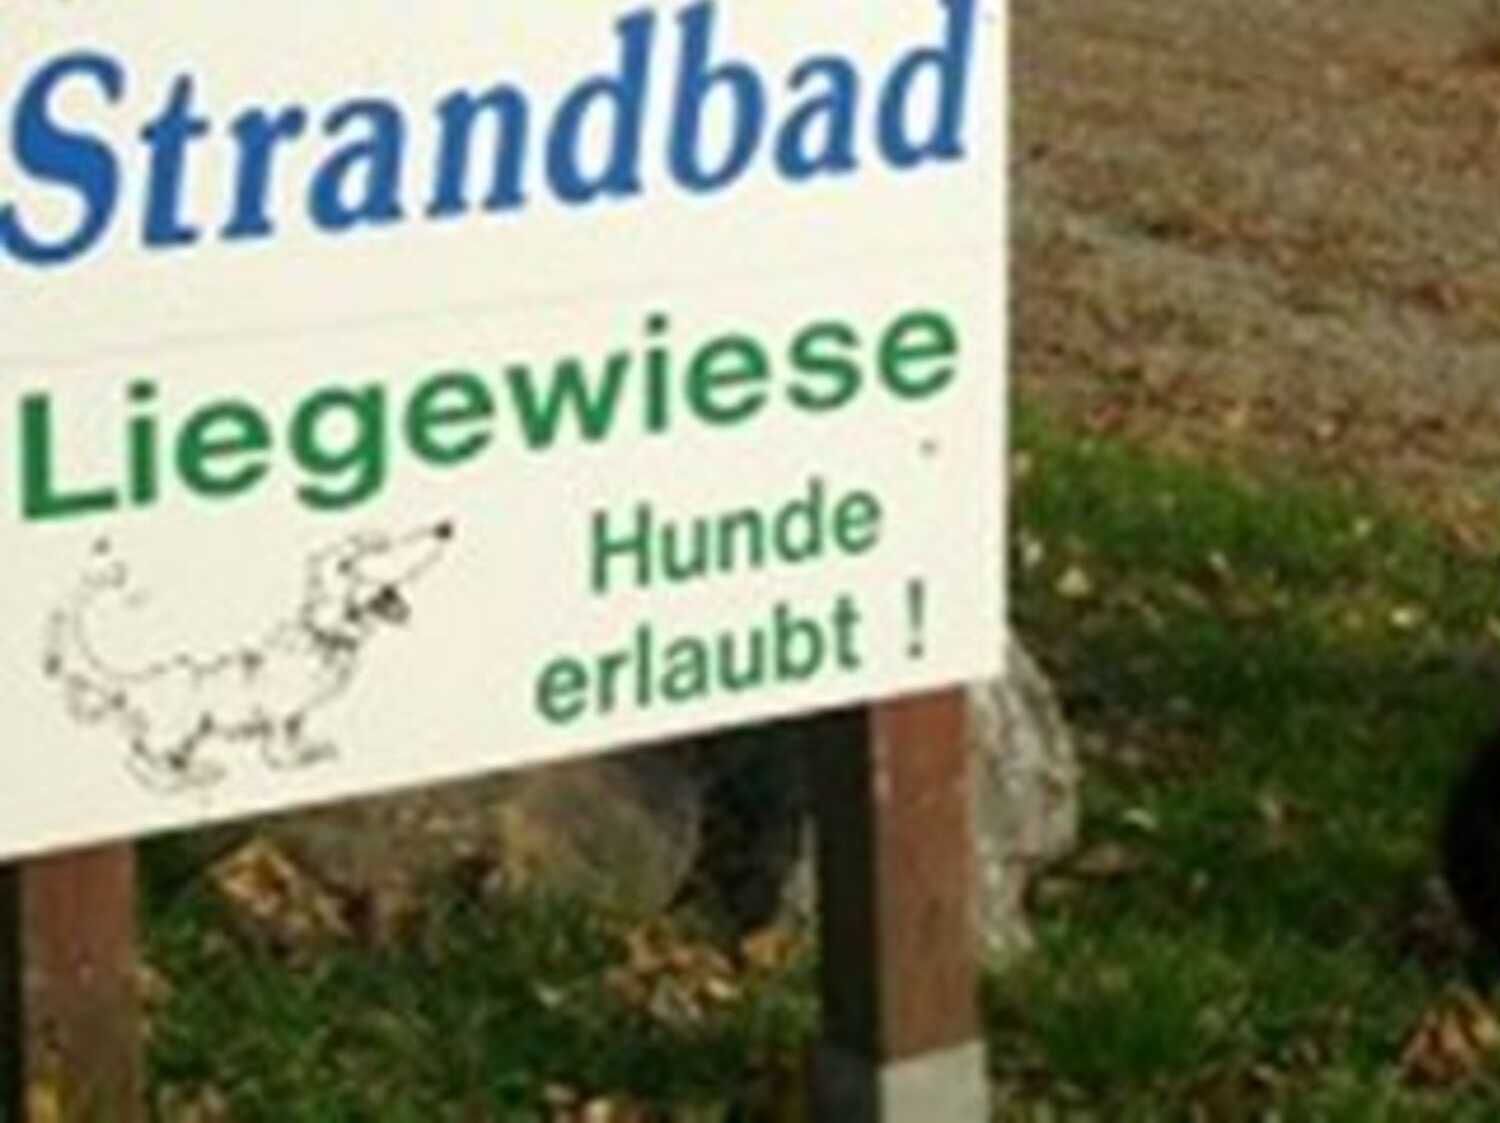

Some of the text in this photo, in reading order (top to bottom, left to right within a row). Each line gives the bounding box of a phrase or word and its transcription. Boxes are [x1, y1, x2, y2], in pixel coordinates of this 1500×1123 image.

[18, 307, 960, 521] Liegewiese
[590, 477, 882, 594] Hunde
[533, 594, 861, 727] erlaubt
